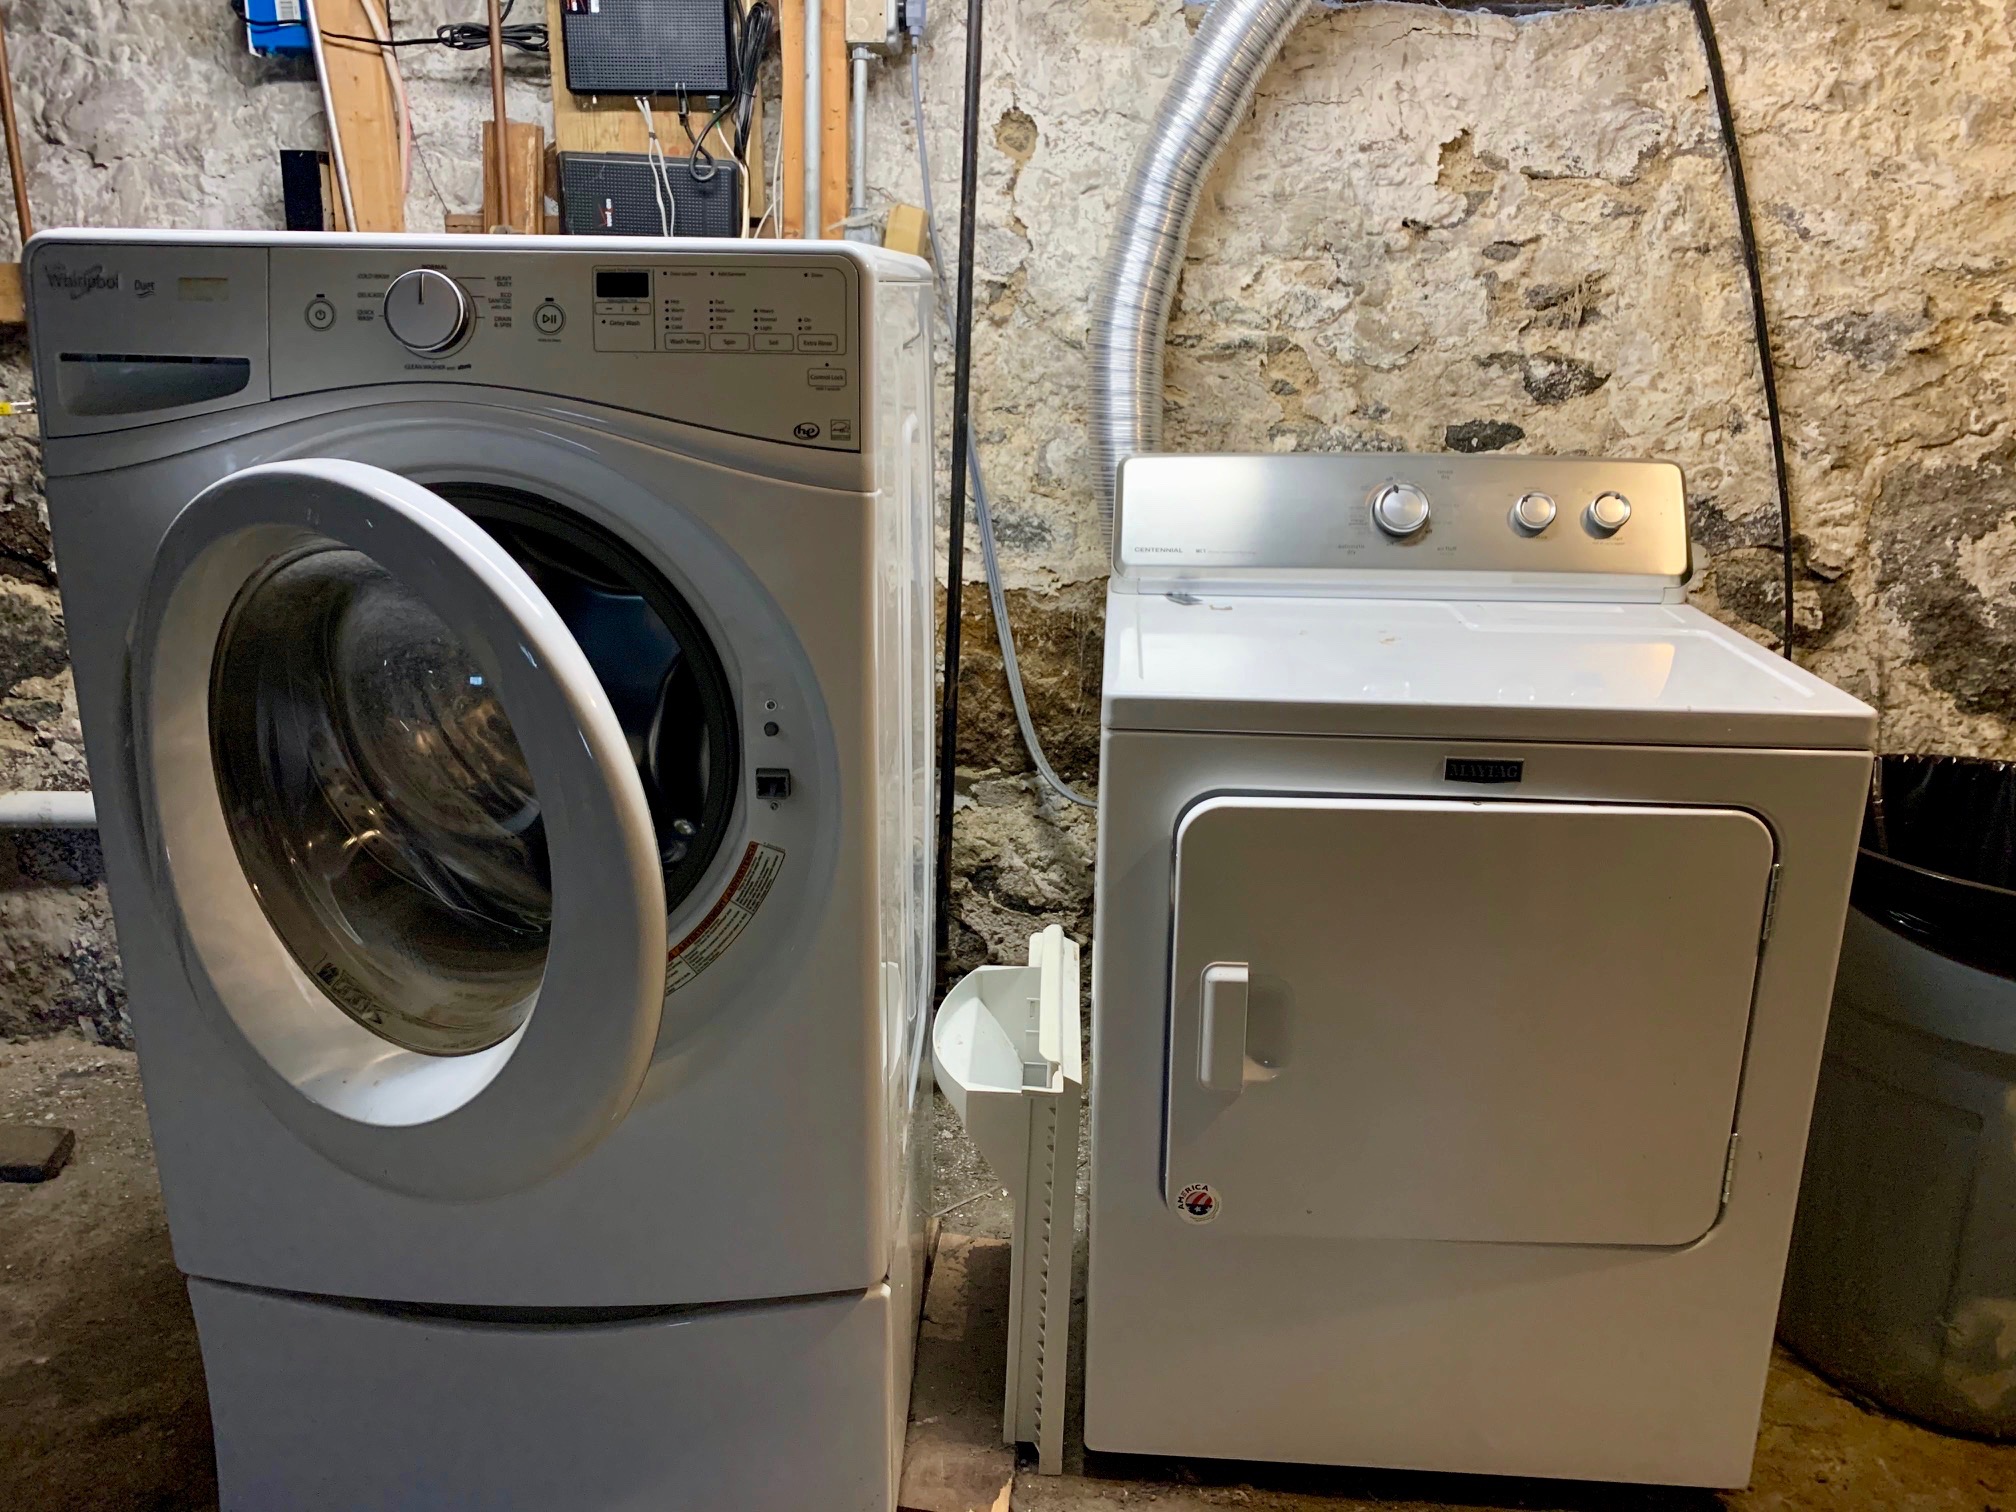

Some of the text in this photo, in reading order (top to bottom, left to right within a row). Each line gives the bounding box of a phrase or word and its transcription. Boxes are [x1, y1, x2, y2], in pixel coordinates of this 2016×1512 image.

[44, 264, 119, 294] Whirlpool
[797, 425, 816, 437] he
[1450, 764, 1518, 777] MAYTAG
[1177, 1184, 1209, 1210] AMERICA
